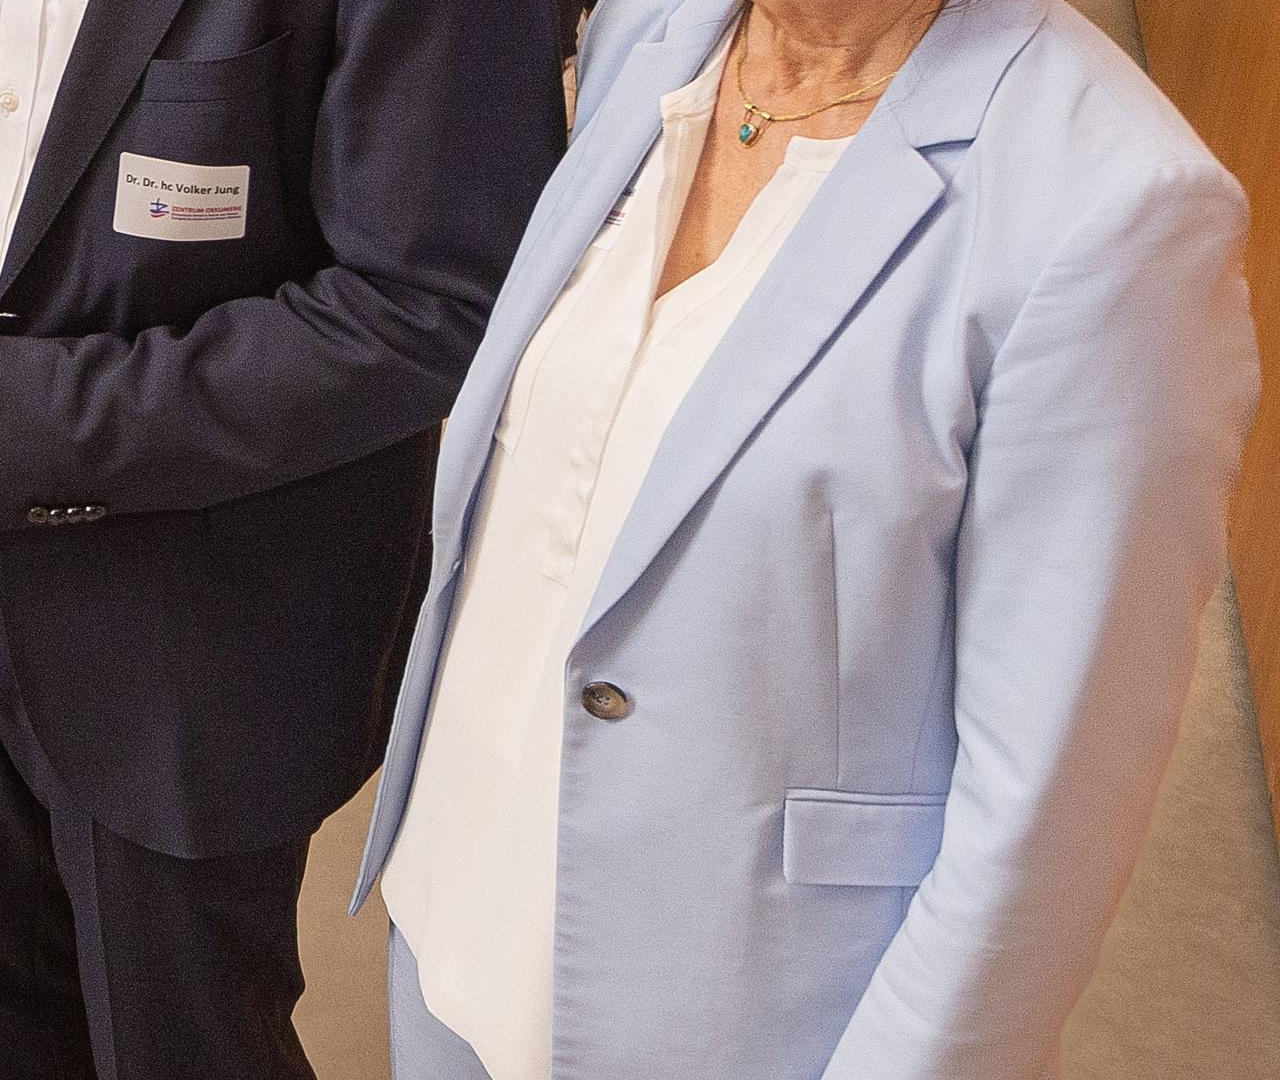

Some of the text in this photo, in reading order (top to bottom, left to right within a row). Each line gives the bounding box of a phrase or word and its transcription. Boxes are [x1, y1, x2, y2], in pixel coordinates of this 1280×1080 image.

[126, 173, 240, 196] Dr. Dr. hc Volker Jung
